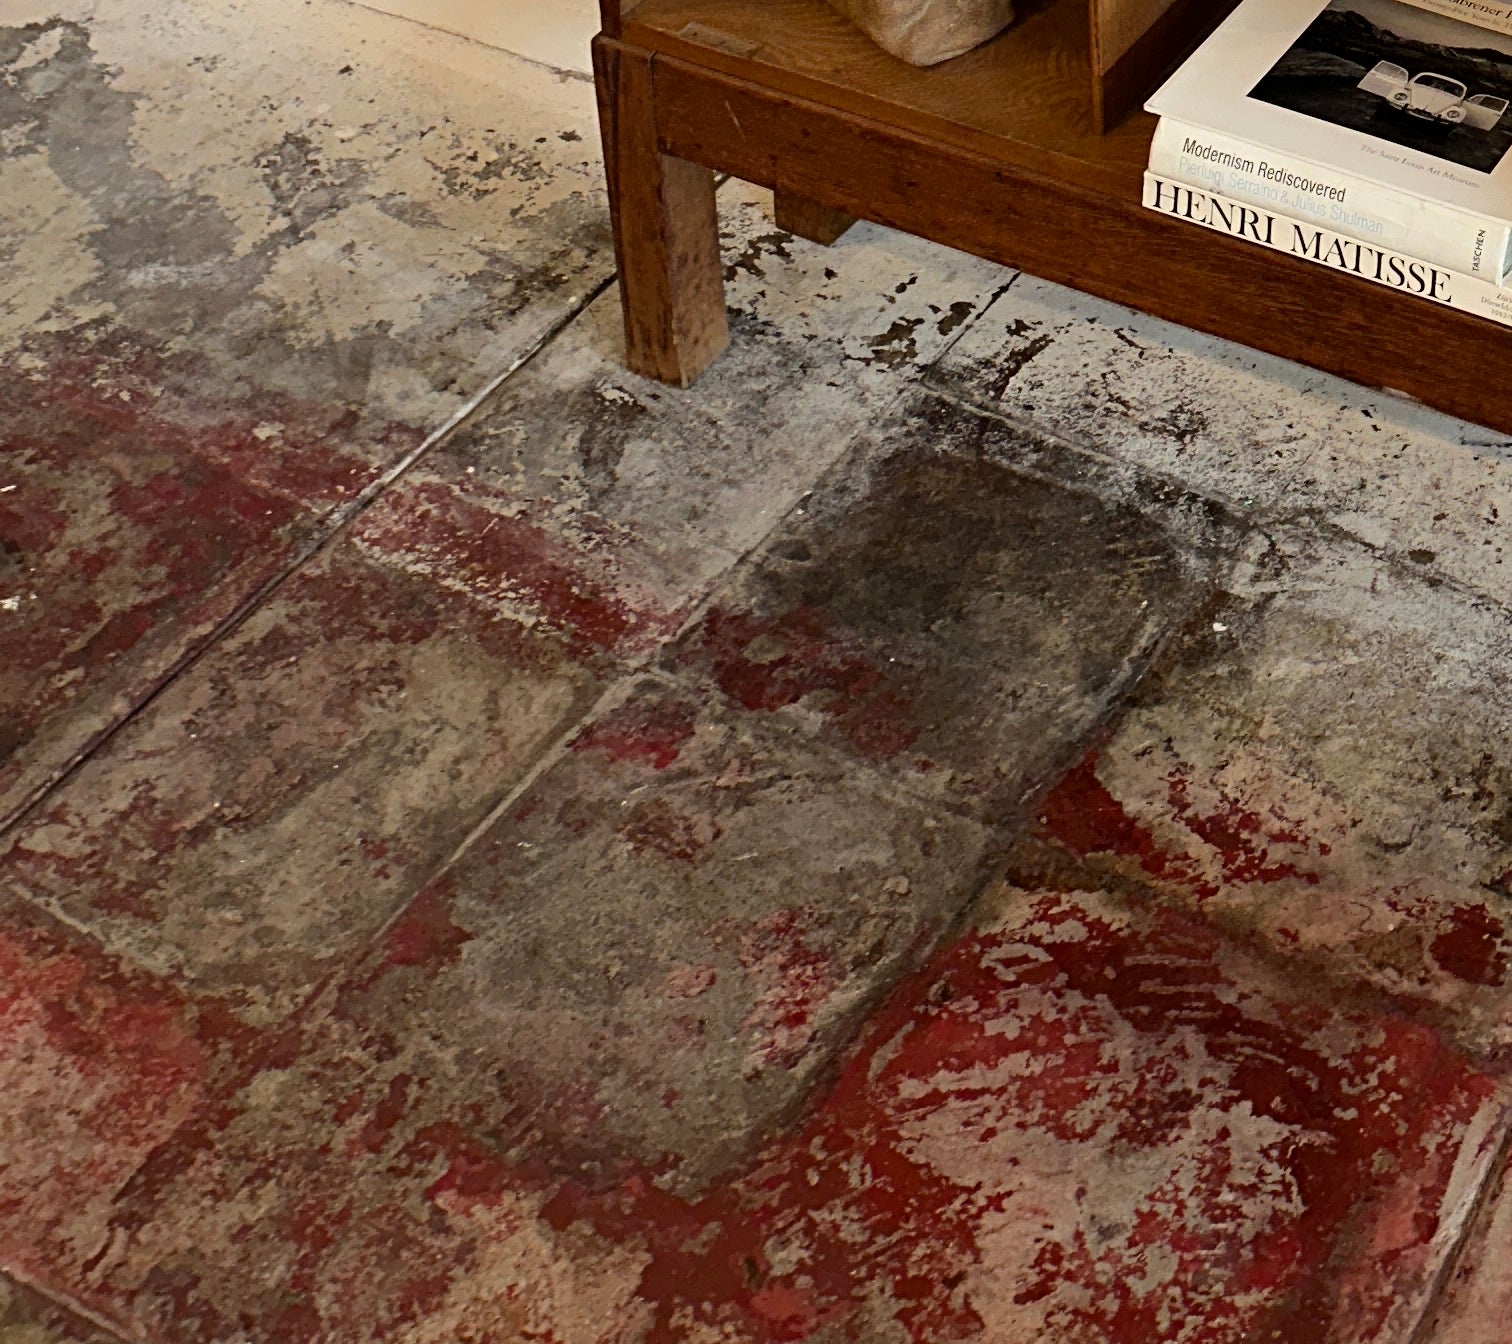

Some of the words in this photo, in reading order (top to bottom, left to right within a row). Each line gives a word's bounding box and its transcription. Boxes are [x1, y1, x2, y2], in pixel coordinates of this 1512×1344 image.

[1179, 157, 1225, 188] Pierluigi
[1229, 172, 1279, 201] Serraino
[1280, 190, 1289, 204] &
[1291, 192, 1327, 217] Julius
[1330, 203, 1384, 235] Shulman
[1182, 137, 1255, 174] Modernism
[1257, 161, 1347, 203] Rediscovered
[1151, 180, 1277, 245] HENRI
[1289, 223, 1453, 303] MATISSE
[1472, 229, 1486, 272] TASCHEN
